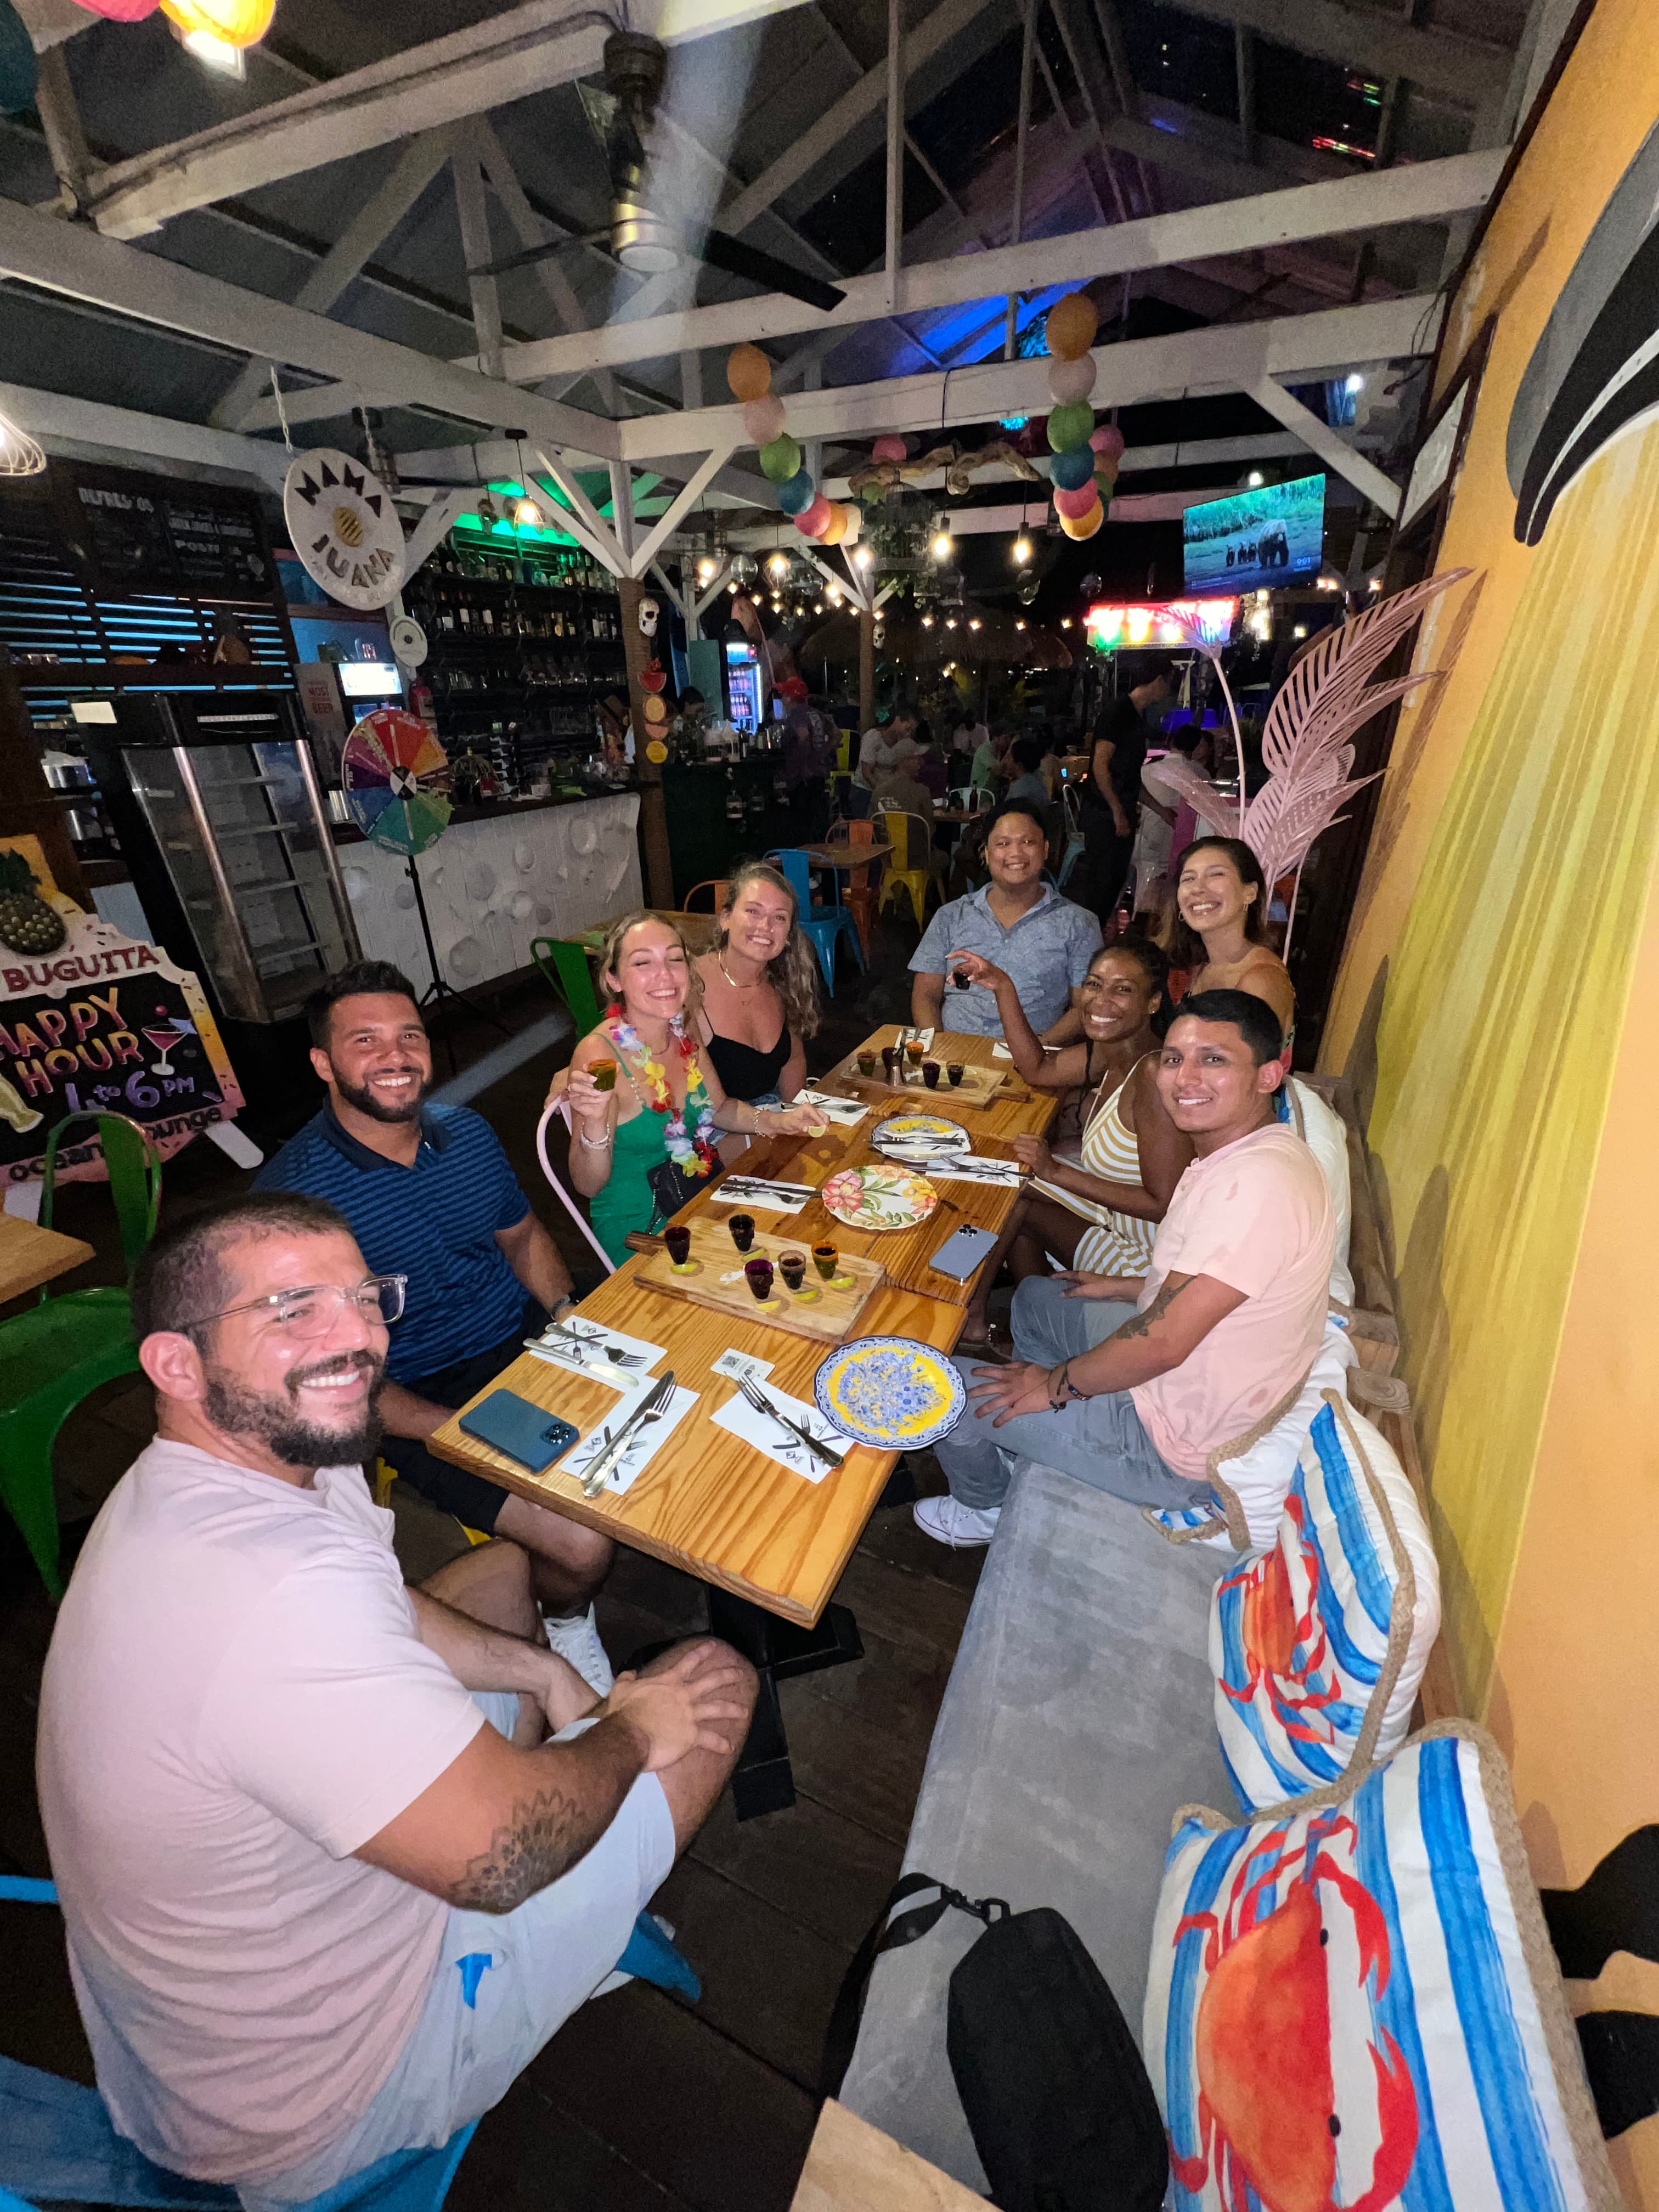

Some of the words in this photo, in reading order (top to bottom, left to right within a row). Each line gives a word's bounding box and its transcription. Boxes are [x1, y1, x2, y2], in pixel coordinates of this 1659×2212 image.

[294, 460, 382, 518] MAMA
[2, 945, 160, 992] BUGUITA
[15, 1031, 144, 1097] HOUR
[93, 1085, 121, 1101] to
[125, 1070, 160, 1108] 6
[162, 1076, 195, 1097] PM
[144, 1107, 221, 1141] unge
